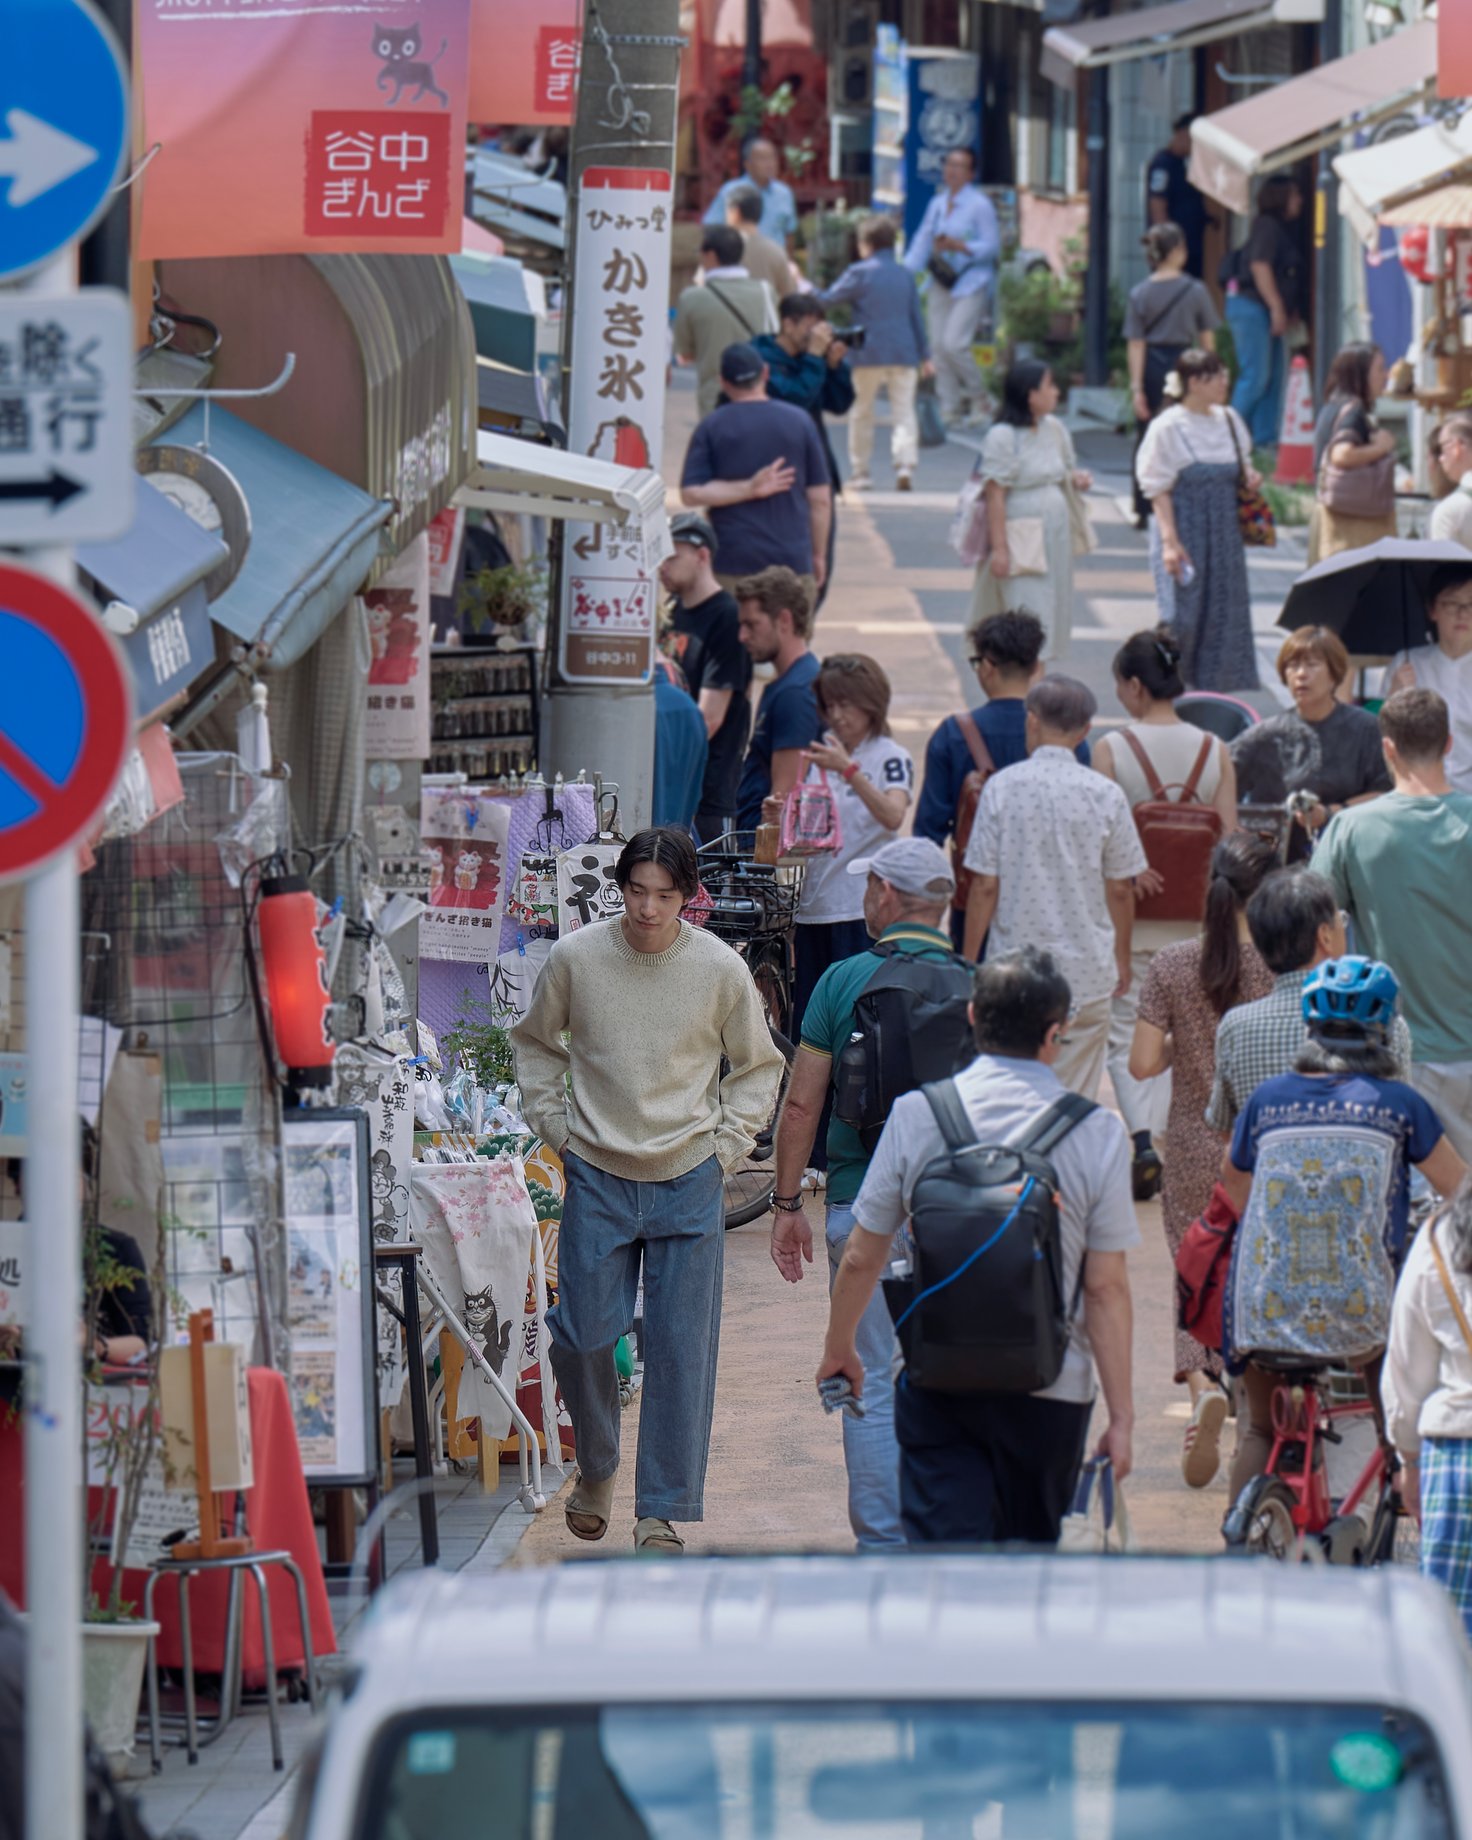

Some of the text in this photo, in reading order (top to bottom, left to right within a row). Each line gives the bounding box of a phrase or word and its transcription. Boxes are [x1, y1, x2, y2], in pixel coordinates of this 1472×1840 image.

[325, 131, 429, 172] 谷中
[322, 178, 430, 219] ぎんざ
[586, 205, 668, 233] ひみつ堂
[597, 248, 648, 402] かき氷
[421, 911, 492, 928] ぎんざ招き猫
